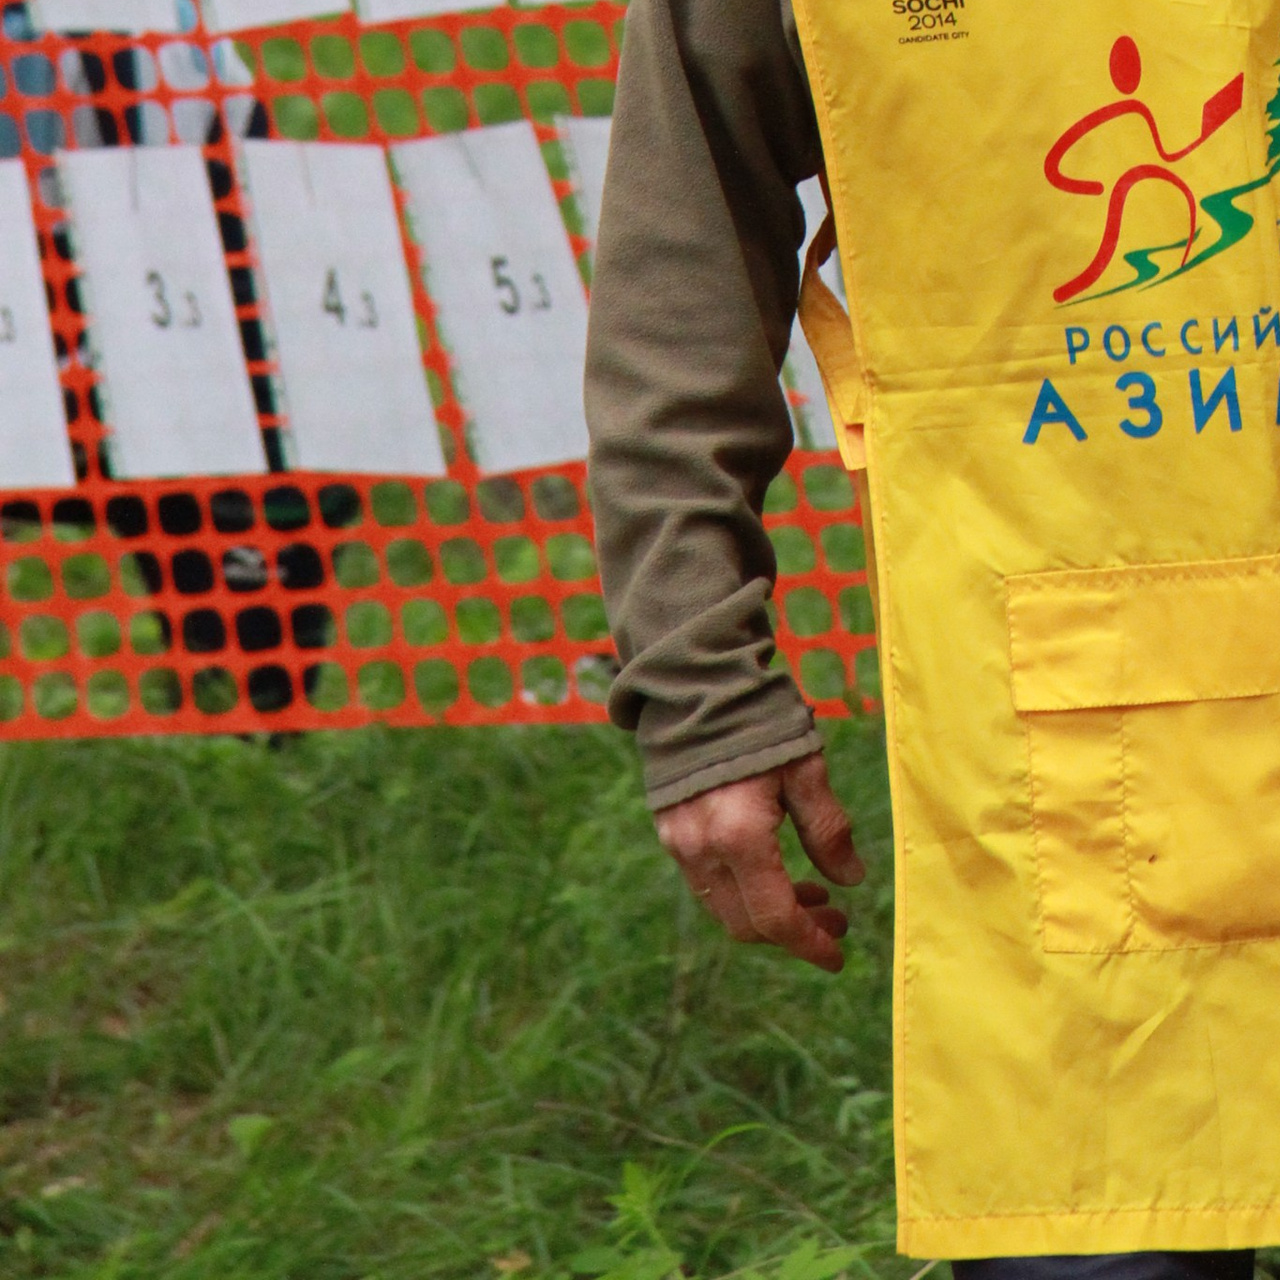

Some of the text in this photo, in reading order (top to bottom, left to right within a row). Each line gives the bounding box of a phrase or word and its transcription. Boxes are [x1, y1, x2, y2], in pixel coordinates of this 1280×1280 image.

[908, 11, 957, 31] 2014
[898, 31, 969, 44] CANDIDATE CITY
